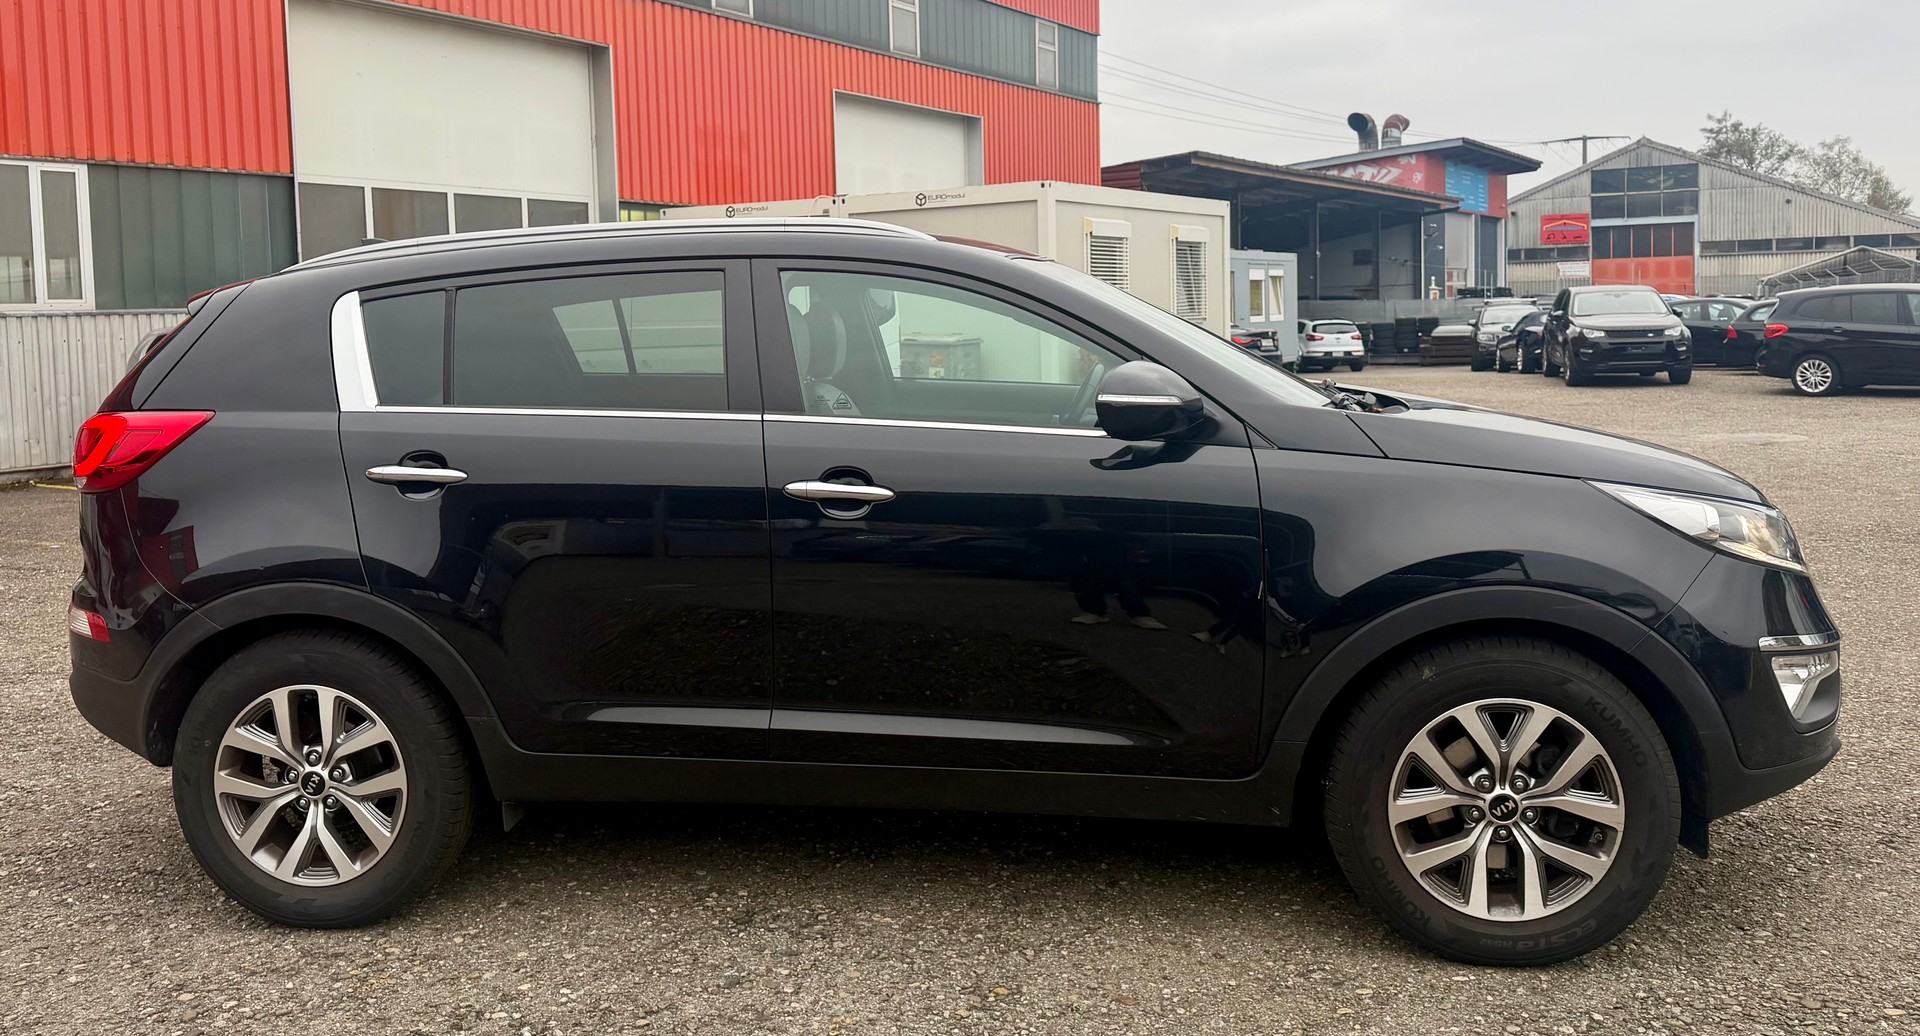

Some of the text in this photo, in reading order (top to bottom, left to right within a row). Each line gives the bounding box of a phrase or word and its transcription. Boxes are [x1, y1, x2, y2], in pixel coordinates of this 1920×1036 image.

[1584, 695, 1648, 767] KUMHO
[305, 774, 321, 793] KIA
[1491, 799, 1516, 817] KIA
[1371, 855, 1432, 929] KUMHO
